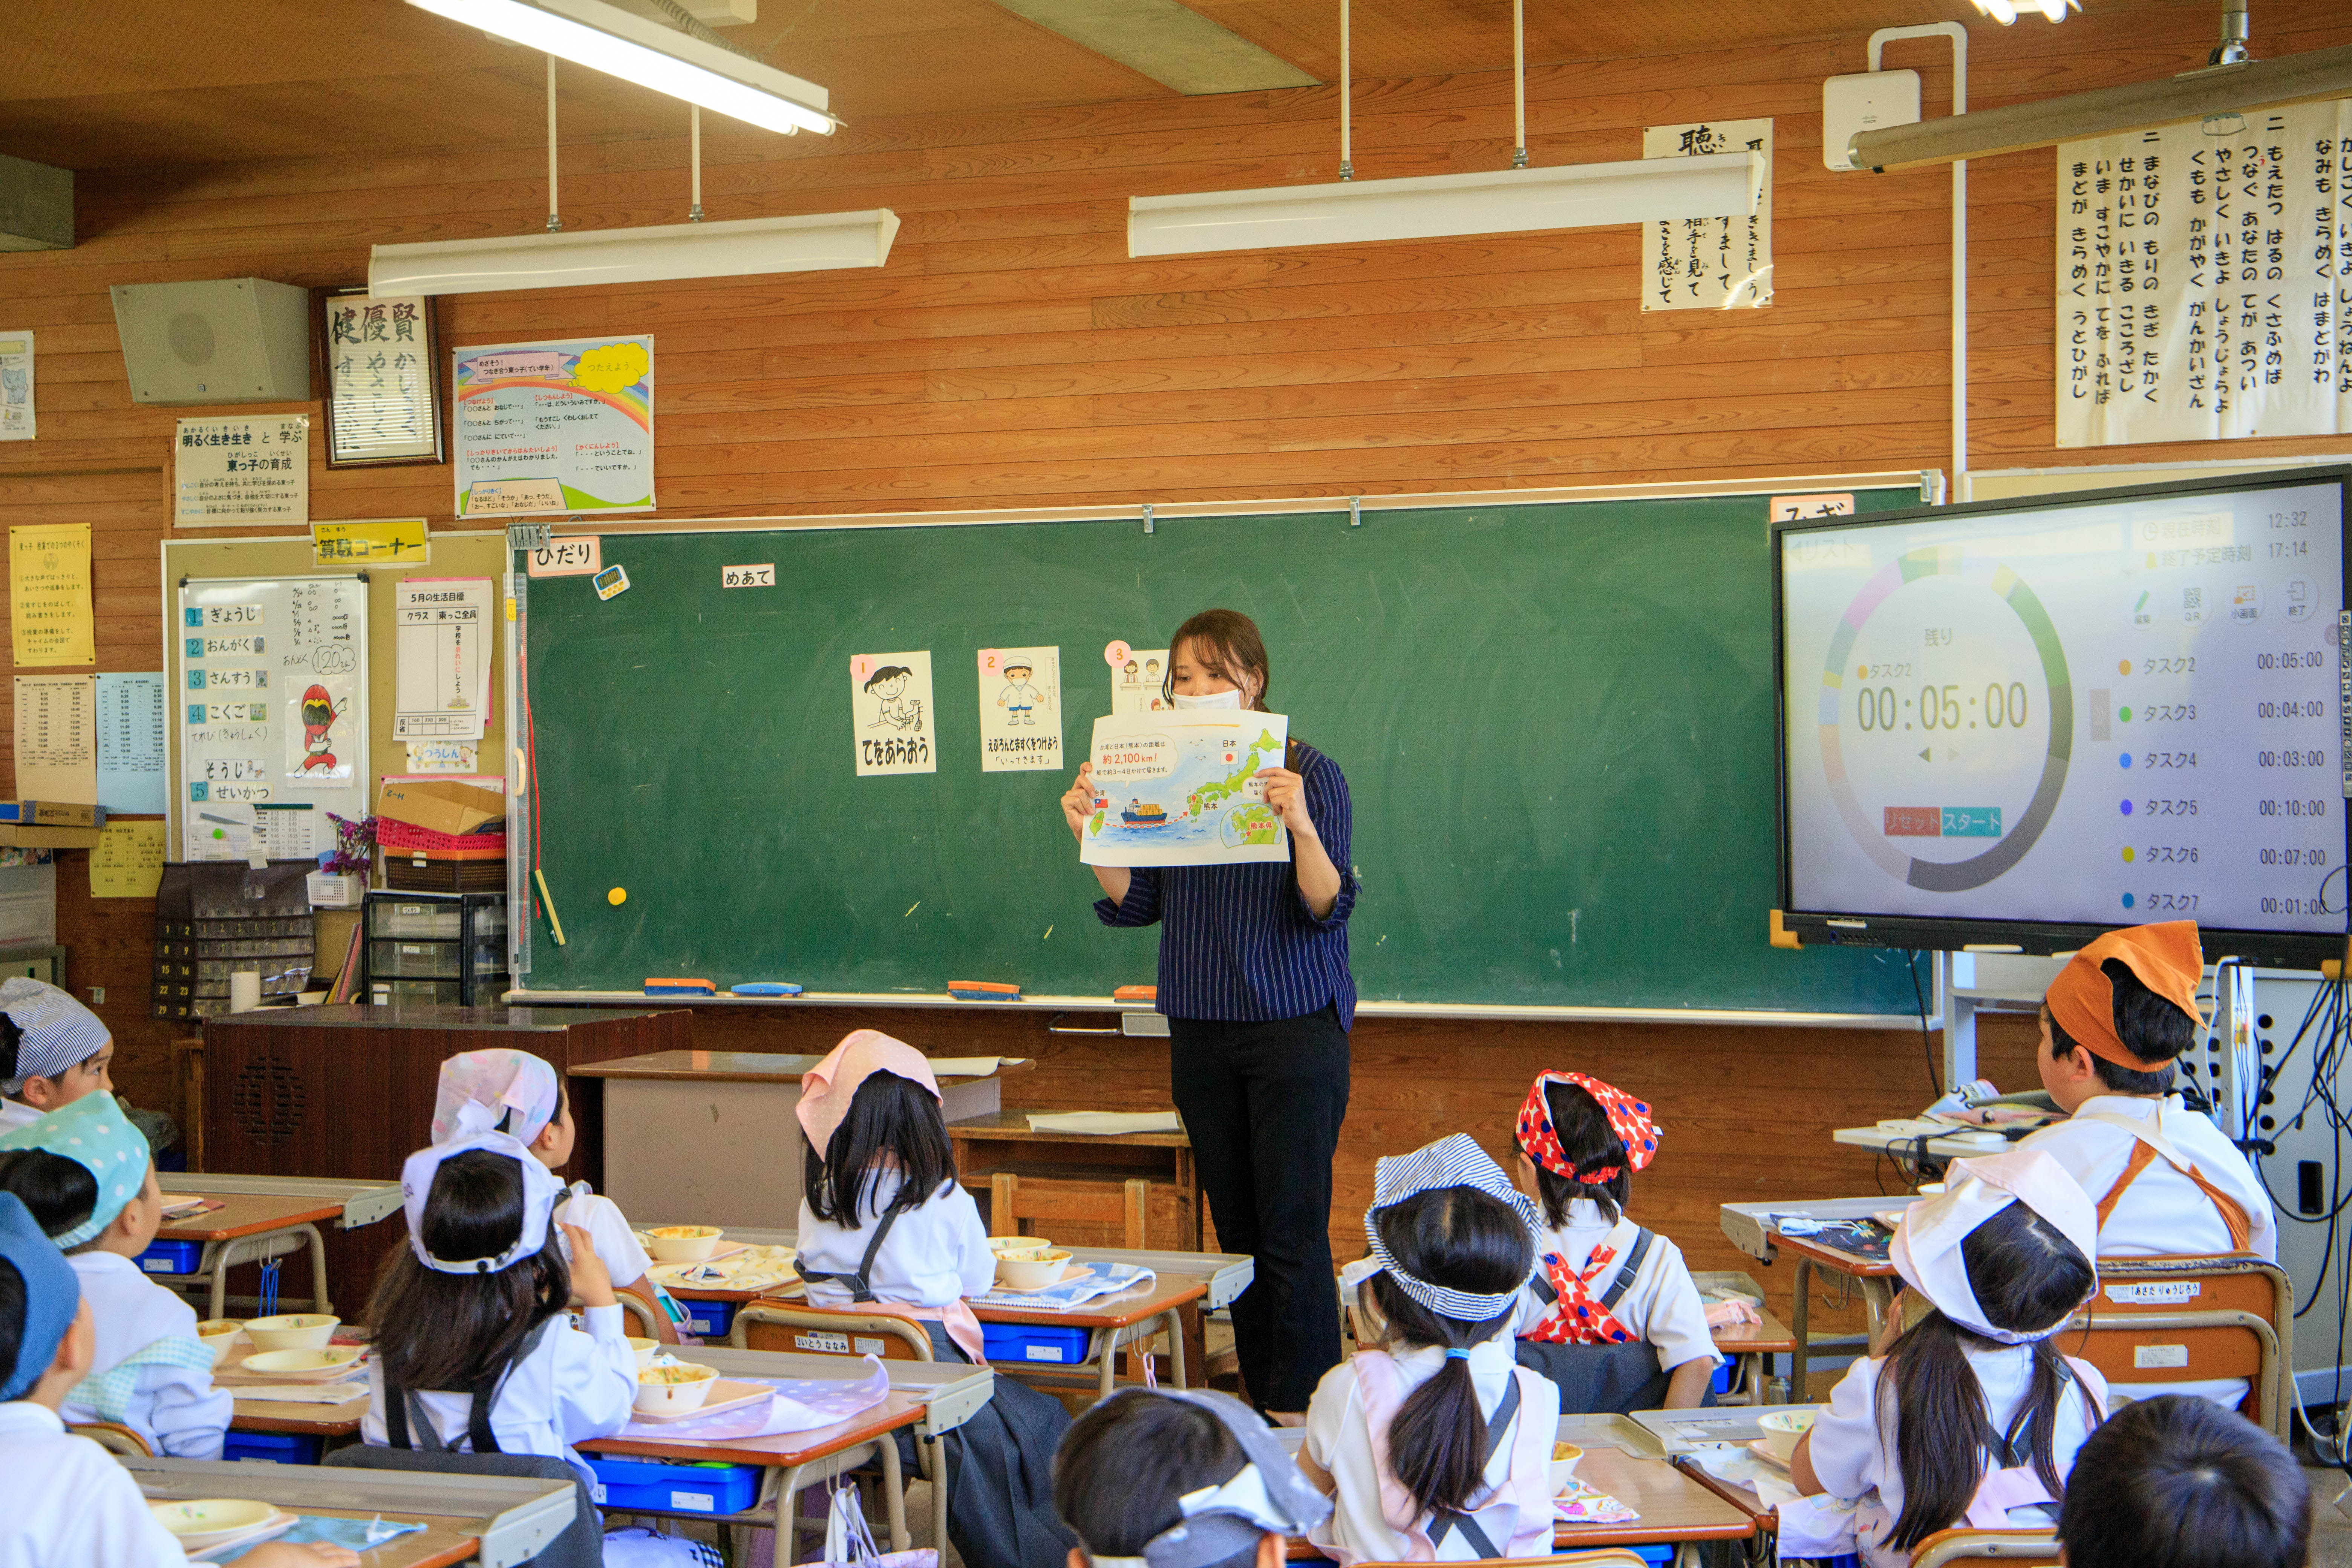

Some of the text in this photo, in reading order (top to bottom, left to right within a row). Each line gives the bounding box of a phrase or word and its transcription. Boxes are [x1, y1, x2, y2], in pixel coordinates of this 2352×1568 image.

[2316, 139, 2332, 192] なみも
[2267, 146, 2283, 215] もえたつ
[2315, 207, 2332, 279] きらめく
[2072, 228, 2087, 297] きらめく
[2266, 230, 2283, 280] はるの
[2119, 158, 2136, 392] せかいに いきる こころざし
[2241, 145, 2259, 390] つなぐ あなたの てが あつい
[2095, 160, 2110, 405] いま すこやかに てを ふれば
[2144, 156, 2159, 403] まなびの もりの きぎ たかく
[2189, 151, 2206, 409] くもも かがやく がんかいざん
[2215, 149, 2231, 414] やさしく いきよ しょうじょらよ
[331, 307, 361, 345] 健
[359, 304, 390, 342] 優
[392, 303, 419, 342] 賢
[2266, 294, 2282, 384] くさふめば
[2072, 311, 2086, 398] うとひがし
[588, 362, 630, 372] つたえよう
[183, 431, 302, 447] 明るく生き生き と 学ぶ
[227, 458, 292, 472] 東っ子の育成
[2268, 510, 2307, 528] 12:32
[320, 538, 422, 558] 算数コーナー
[535, 542, 590, 566] ひだり
[2162, 541, 2308, 566] 終了予定時刻 17:14
[727, 570, 770, 586] めあて
[411, 592, 464, 603] 5月の生活目標
[192, 606, 255, 623] 1 ぎょうじ
[407, 611, 476, 620] クラス 東っこ全員
[1925, 628, 1953, 646] 残り
[191, 639, 250, 654] 2 おんがく
[1116, 648, 1123, 660] 3
[862, 662, 865, 673] 1
[988, 656, 995, 668] 2
[1870, 663, 1911, 678] タスク2
[2144, 651, 2323, 674] タスク2 00:05:00
[194, 672, 250, 686] 3 さんすう
[192, 704, 246, 721] 4 こくご
[1858, 682, 2027, 732] 00:05:00
[2144, 701, 2323, 721] タスク3 00:04:00
[400, 719, 406, 733] 反省
[862, 737, 928, 766] てをあらおう
[988, 736, 1058, 752] えぷろんとますくをつけよう
[425, 749, 458, 758] つうしん
[995, 755, 1049, 765] 「いってきます」
[2145, 751, 2324, 768] タスク4 00:03:00
[207, 762, 242, 779] そうじ
[196, 784, 268, 799] 5 せいかつ
[2146, 800, 2325, 816] タスク5 00:10:00
[1250, 822, 1272, 830] 熊本県
[1885, 813, 1939, 829] リセット
[1944, 813, 2000, 829] スタート
[2147, 846, 2326, 865] タスク6 00:07:00
[2148, 894, 2326, 914] タスク7 00:01:00
[164, 945, 168, 954] 8
[162, 965, 170, 974] 15
[160, 986, 168, 994] 22
[159, 1006, 167, 1014] 29
[825, 1340, 847, 1351] ななみ
